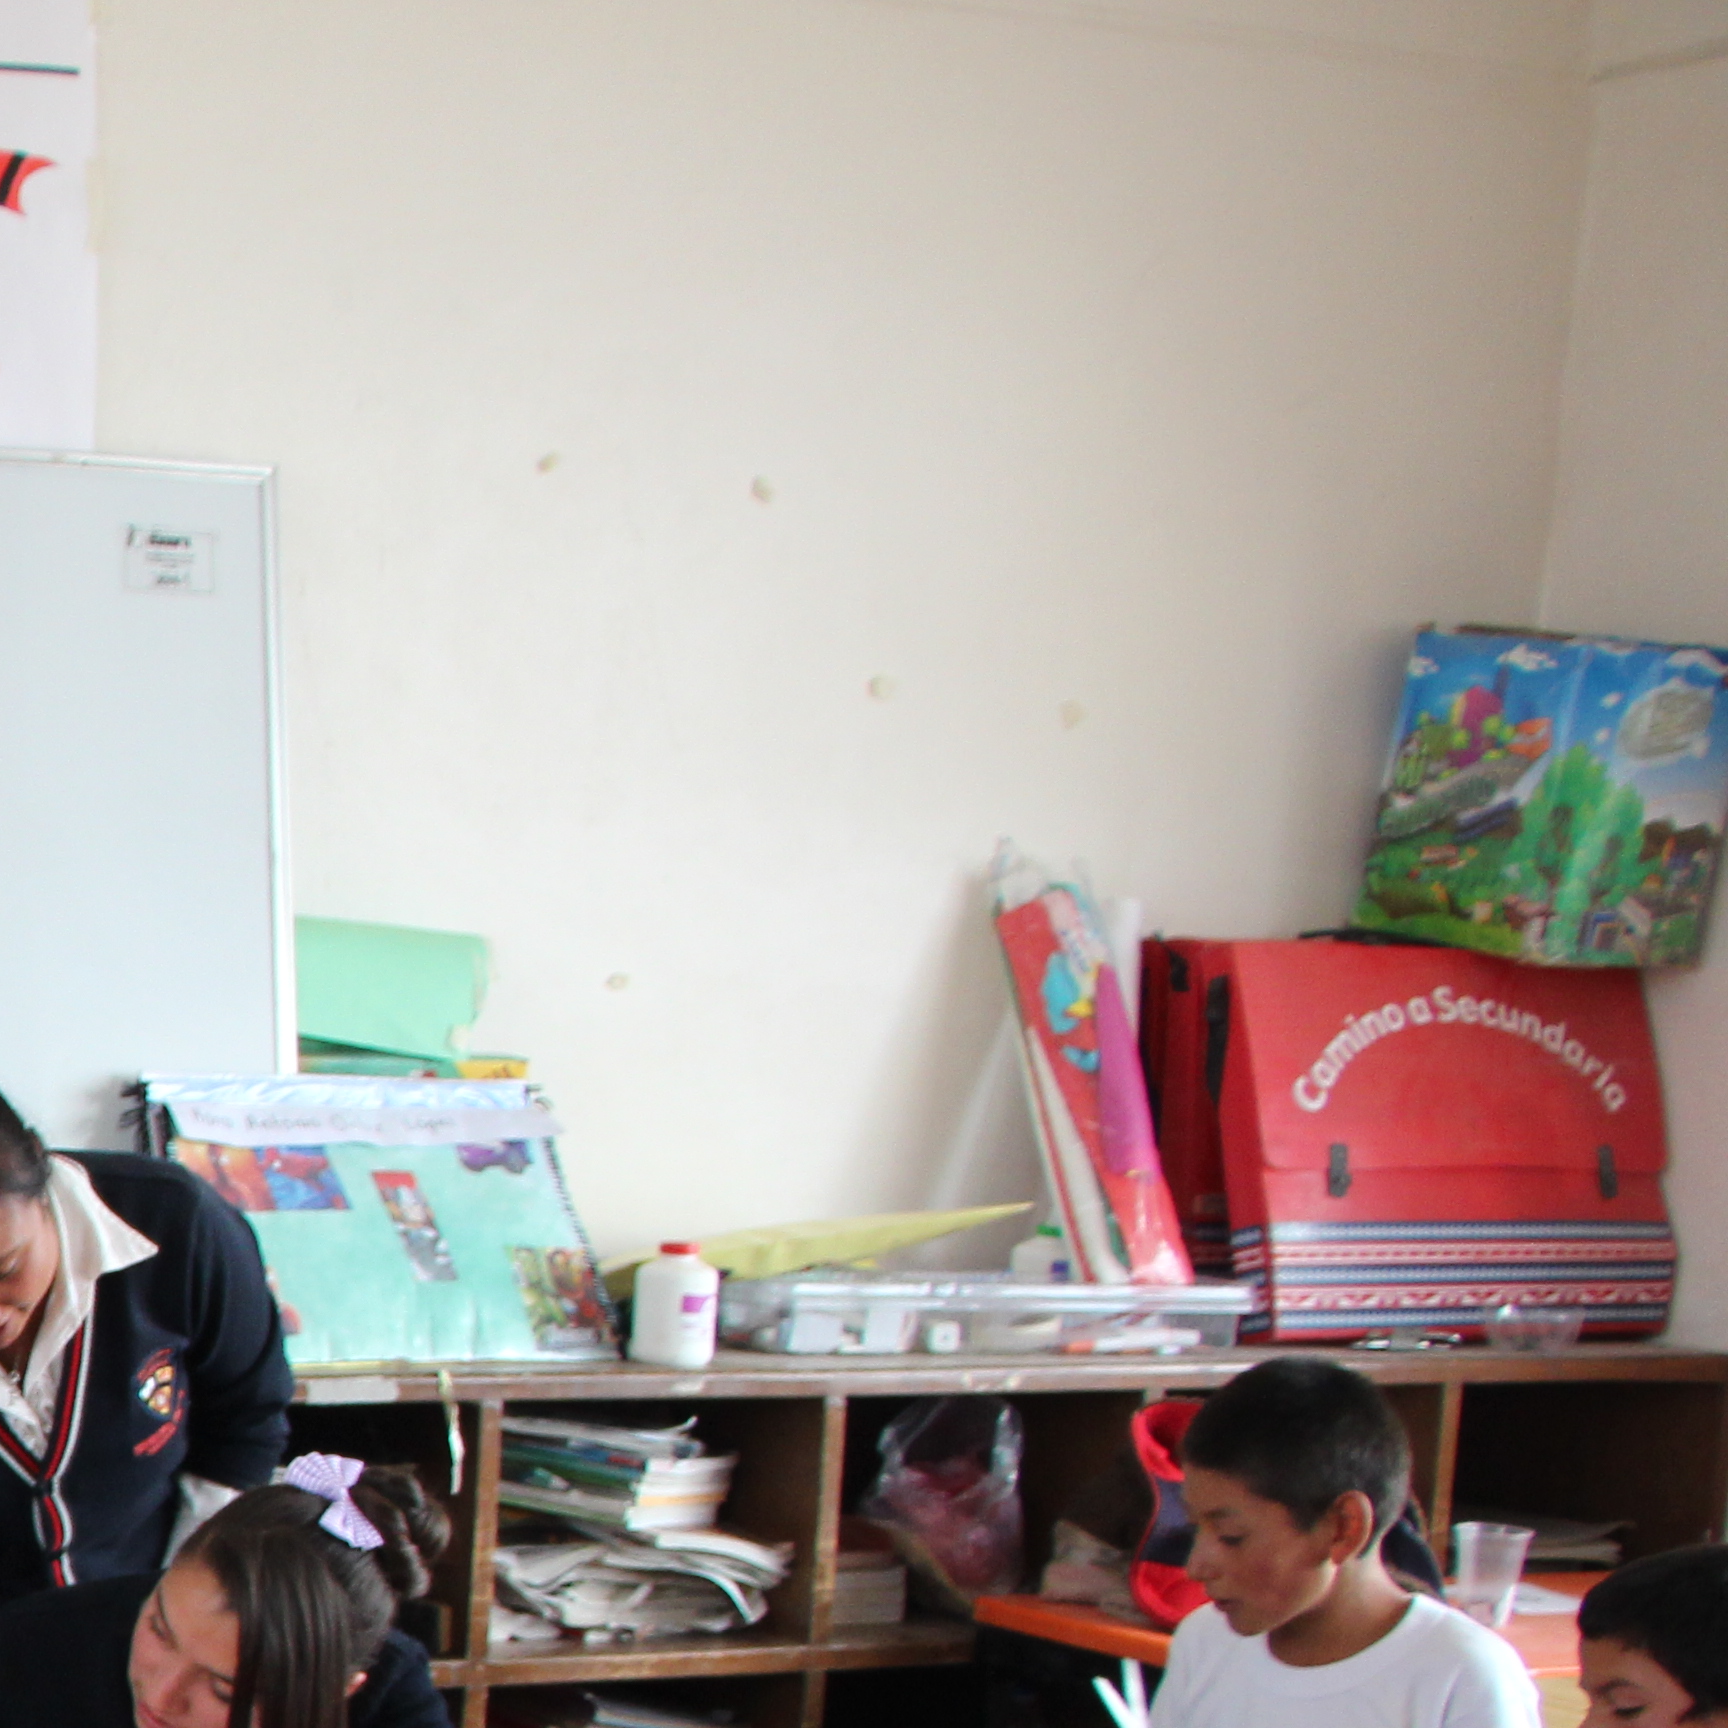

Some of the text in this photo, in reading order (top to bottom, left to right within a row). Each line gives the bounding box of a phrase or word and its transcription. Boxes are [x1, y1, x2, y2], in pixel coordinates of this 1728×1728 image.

[1293, 984, 1627, 1113] Camino a Secundaria
